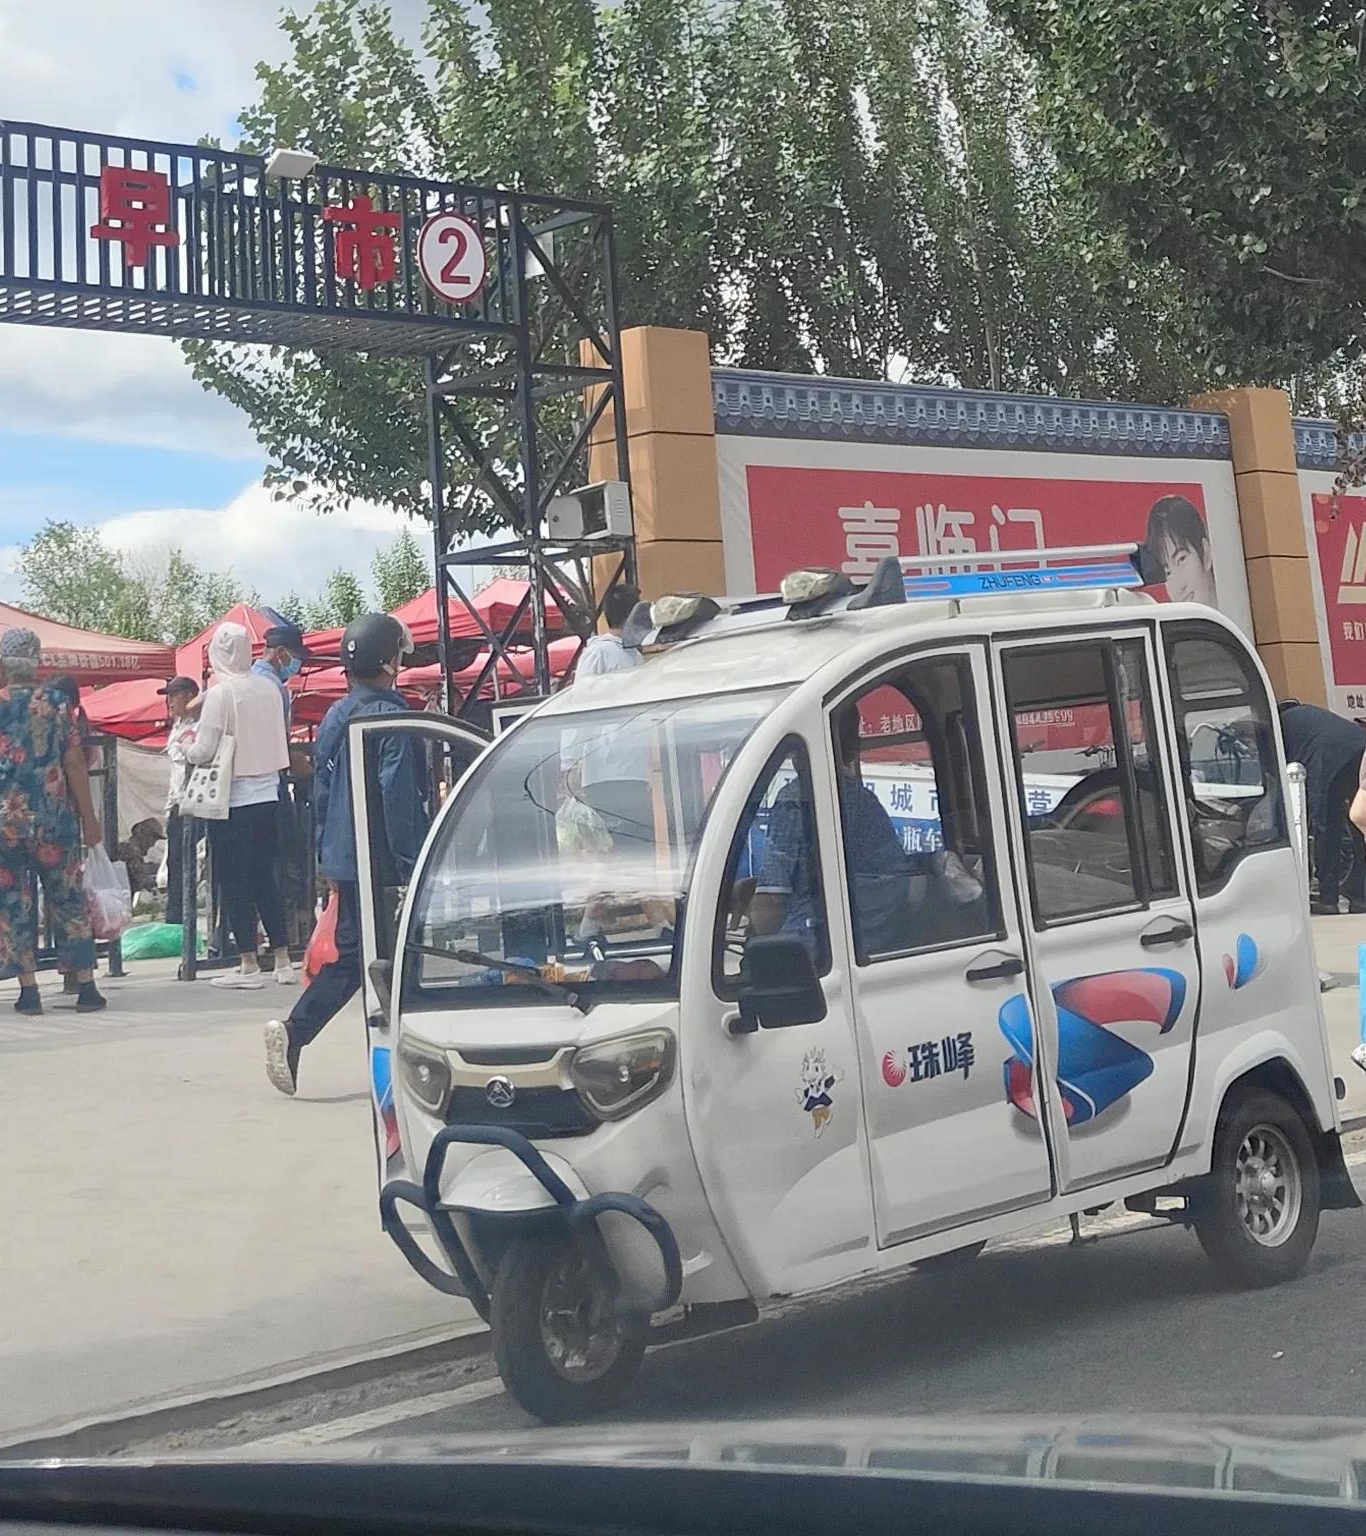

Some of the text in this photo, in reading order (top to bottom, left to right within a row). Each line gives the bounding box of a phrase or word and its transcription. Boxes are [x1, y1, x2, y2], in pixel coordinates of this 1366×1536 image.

[838, 501, 1047, 585] 喜临门
[978, 574, 1042, 590] ZHUFENG
[907, 1031, 975, 1082] 珠峰
